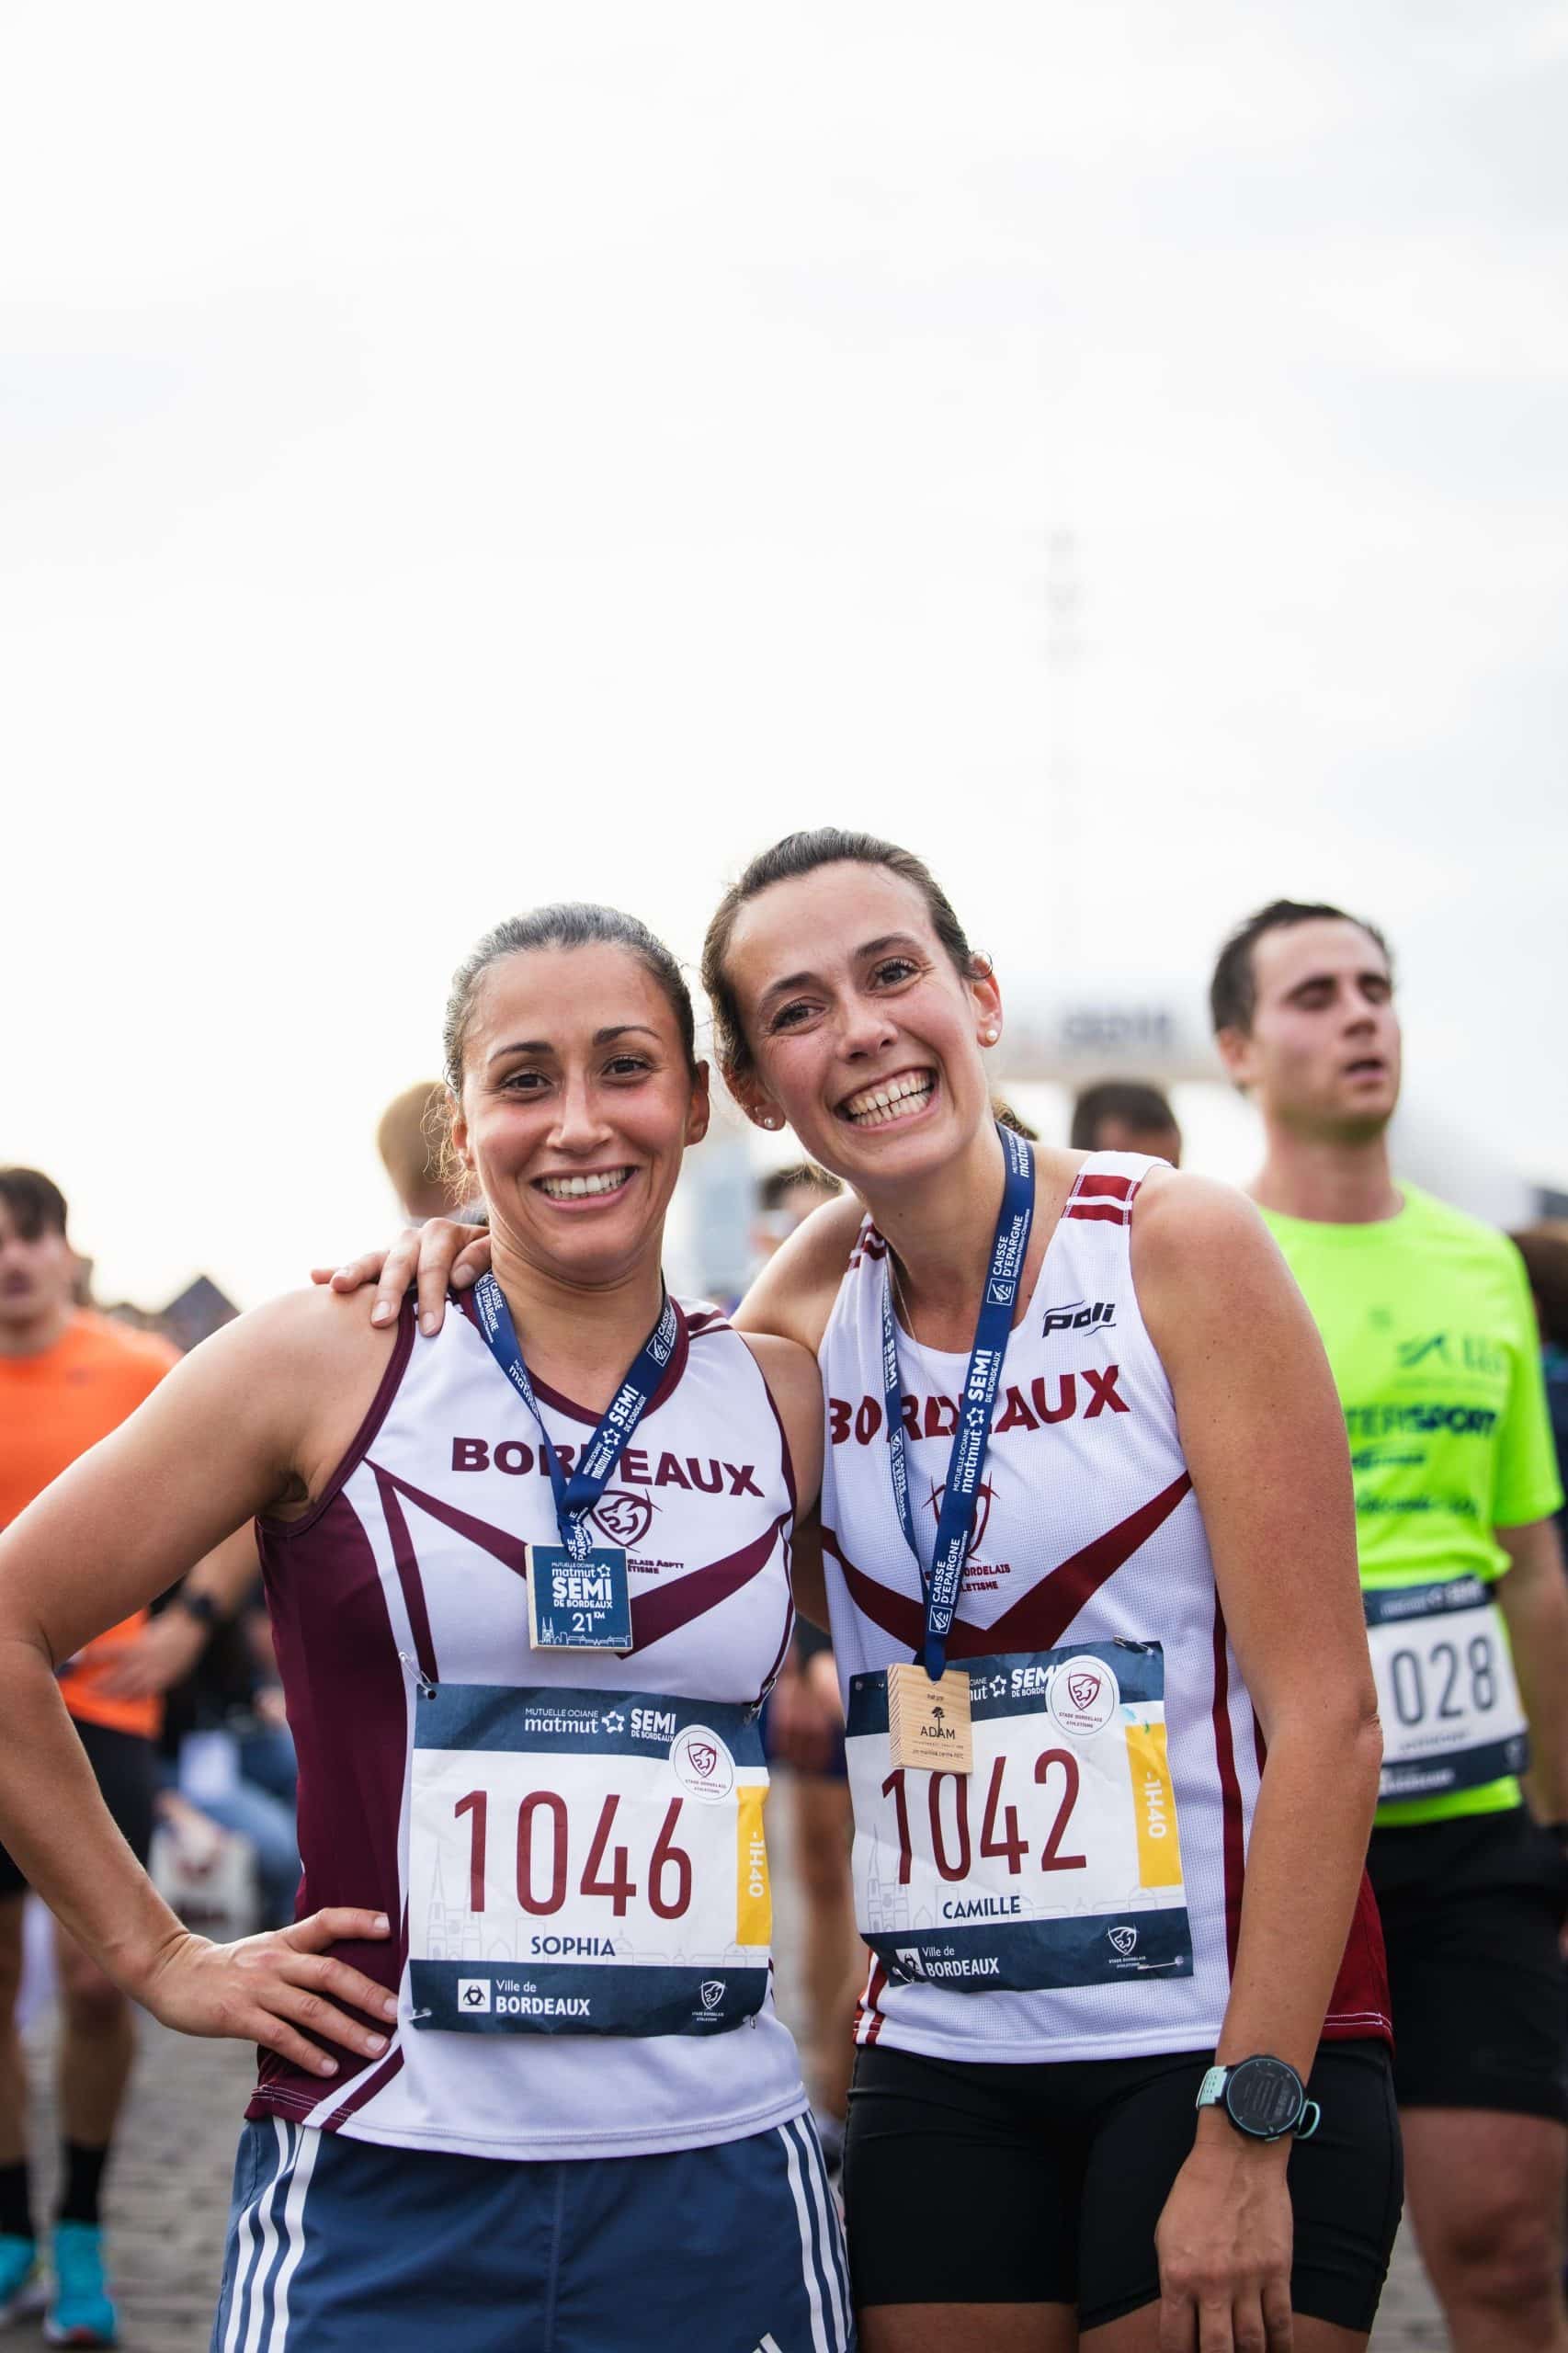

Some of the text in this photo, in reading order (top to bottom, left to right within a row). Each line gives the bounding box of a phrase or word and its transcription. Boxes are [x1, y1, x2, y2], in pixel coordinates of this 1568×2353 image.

[993, 1234, 1009, 1275] CAISSE
[1003, 1214, 1024, 1277] D'EPARGNE
[481, 1289, 500, 1333] D'EPARGNE
[490, 1282, 504, 1311] CAISSE
[887, 1339, 898, 1391] SEMI
[968, 1348, 994, 1402] SEMI
[984, 1351, 1002, 1404] DE BORDEAUX
[608, 1383, 640, 1427] SEMI
[628, 1393, 648, 1424] BORDEAUX
[826, 1364, 1131, 1445] BORDAUX
[450, 1436, 766, 1498] BOREAUX
[590, 1446, 615, 1480] matmut
[952, 1428, 971, 1492] MUTUELLE OCIANE
[961, 1429, 983, 1494] matmut
[551, 1568, 597, 1578] matmut
[933, 1560, 947, 1602] CAISSE
[940, 1538, 961, 1604] D'EPARGNE
[964, 1563, 1011, 1577] ORDELAIS
[551, 1576, 613, 1600] SEMI
[961, 1580, 999, 1593] LETISME
[553, 1599, 613, 1608] DE BORDEAUX
[970, 1677, 987, 1687] CIANE
[1011, 1686, 1045, 1698] DE BORDE
[525, 1708, 599, 1718] MUTUELLE OCIANE
[525, 1717, 599, 1733] matmut
[631, 1708, 676, 1734] SEMI
[631, 1729, 675, 1743] DE BORDEAUX
[920, 1726, 956, 1740] ADAM
[881, 1748, 1087, 1885] 1042
[1146, 1772, 1167, 1839] -1H40
[454, 1790, 693, 1920] 1046
[942, 1895, 1021, 1919] CAMILLE
[530, 1936, 616, 1957] SOPHIA
[922, 1946, 955, 1957] Ville de
[926, 1958, 1000, 1977] BORDEAUX
[495, 1980, 537, 1993] Ville de
[495, 1996, 591, 2017] BORDEAUX
